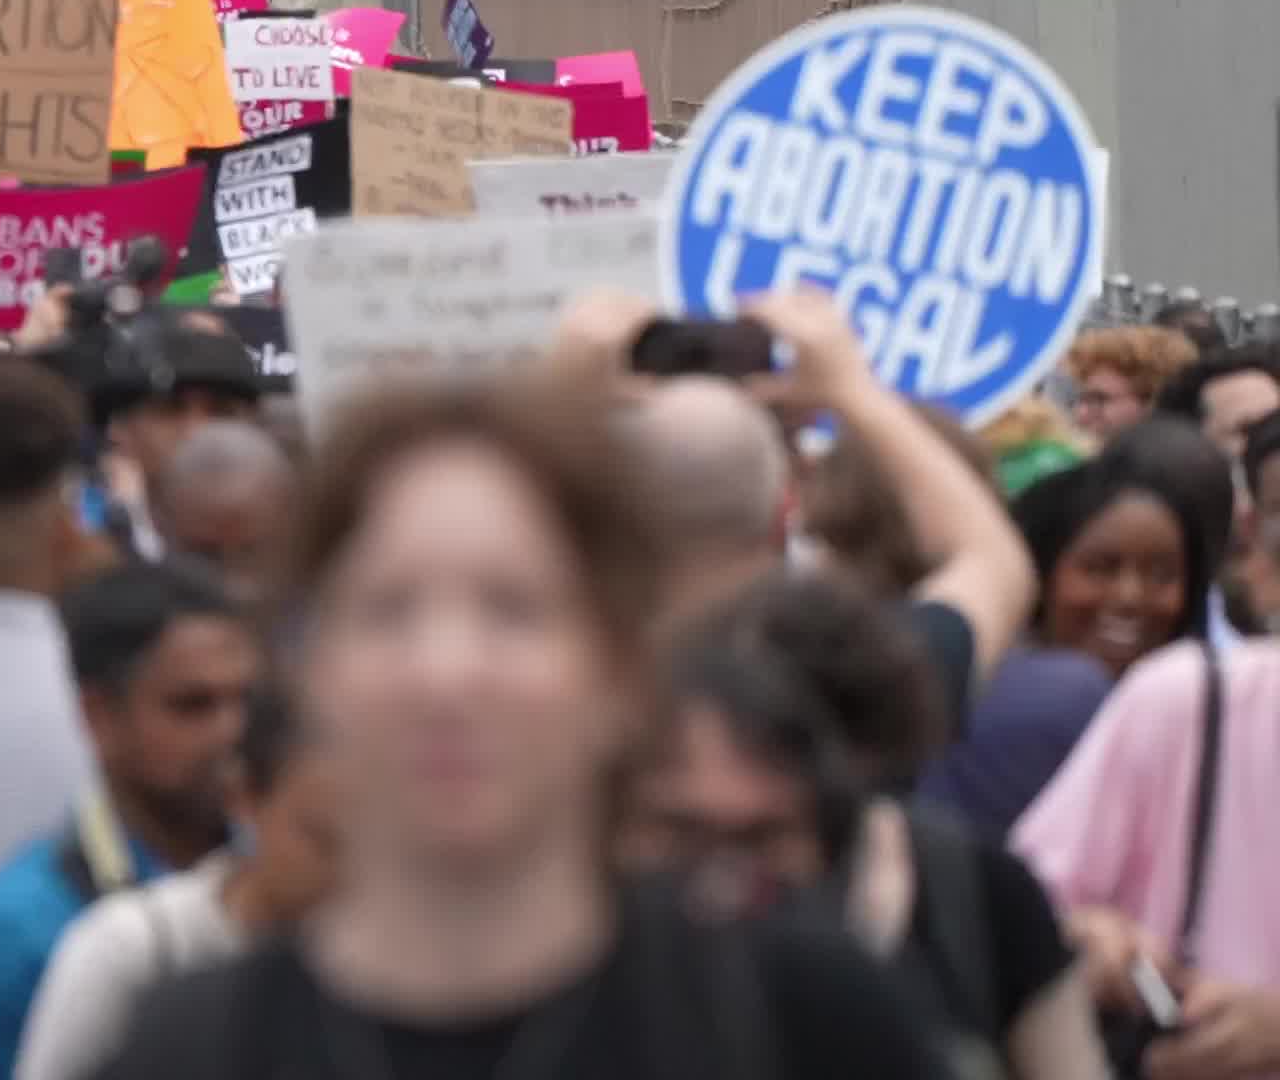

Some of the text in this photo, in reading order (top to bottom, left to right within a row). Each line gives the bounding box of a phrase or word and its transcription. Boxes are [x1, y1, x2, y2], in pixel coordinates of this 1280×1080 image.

[232, 66, 321, 88] TO LIVE
[788, 33, 1049, 166] KEEP
[223, 142, 305, 180] STAND
[221, 185, 288, 212] WITH
[691, 111, 1084, 305] ABORTION
